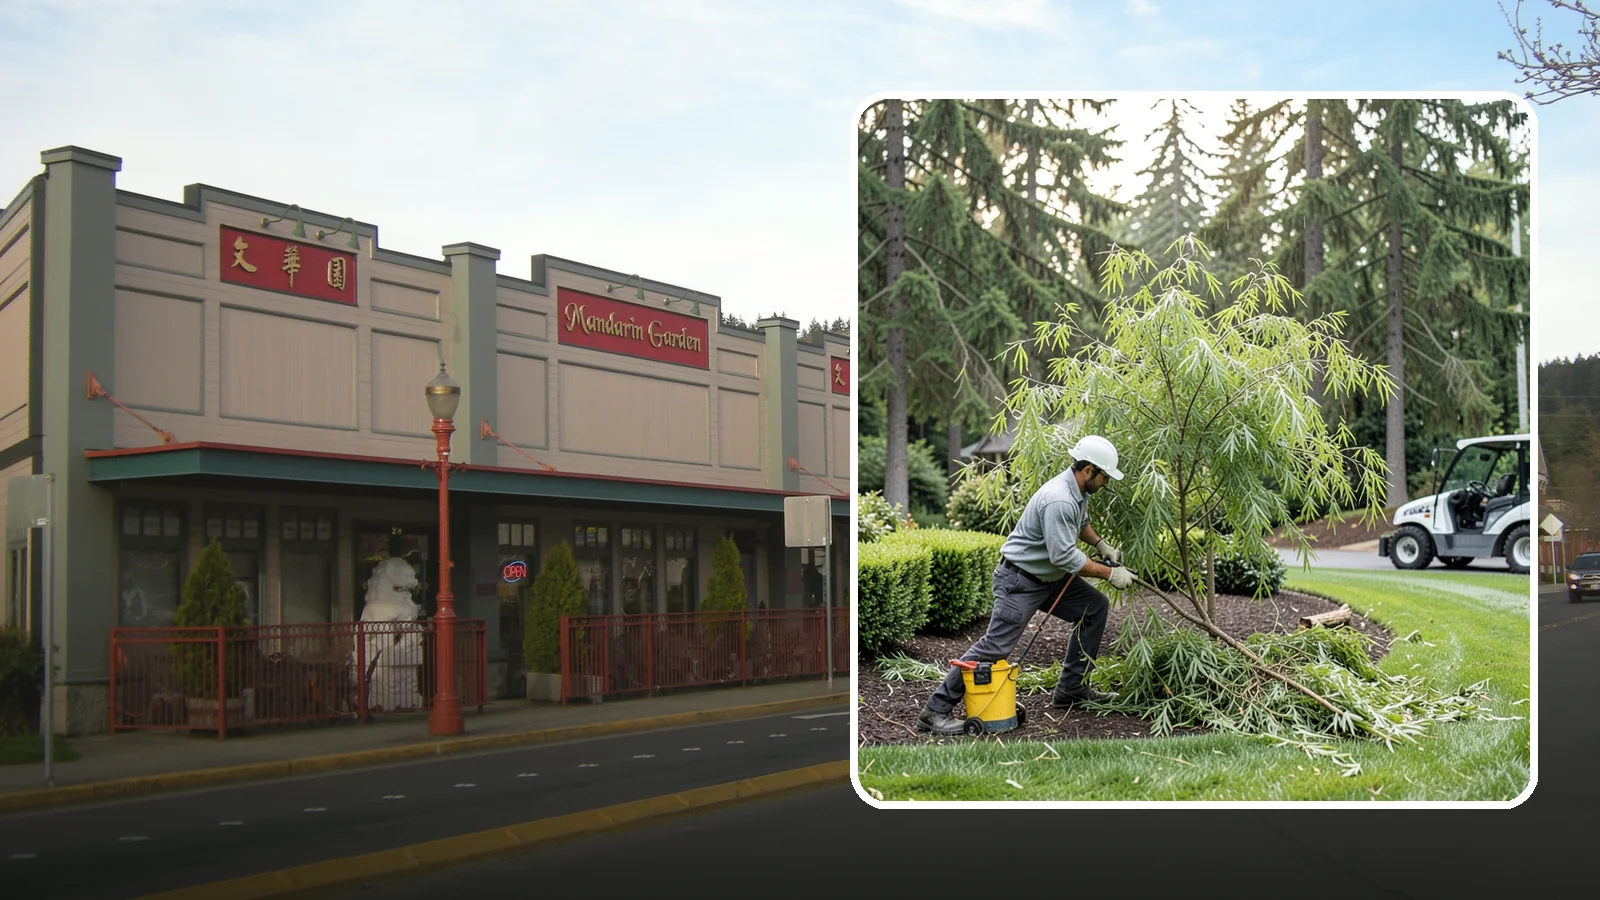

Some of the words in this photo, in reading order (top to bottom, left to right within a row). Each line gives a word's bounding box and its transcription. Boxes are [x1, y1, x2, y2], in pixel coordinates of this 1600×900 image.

[231, 235, 346, 291] 文華園
[564, 302, 644, 341] Mandarin
[648, 320, 702, 352] Garden
[503, 565, 527, 578] OPEN
